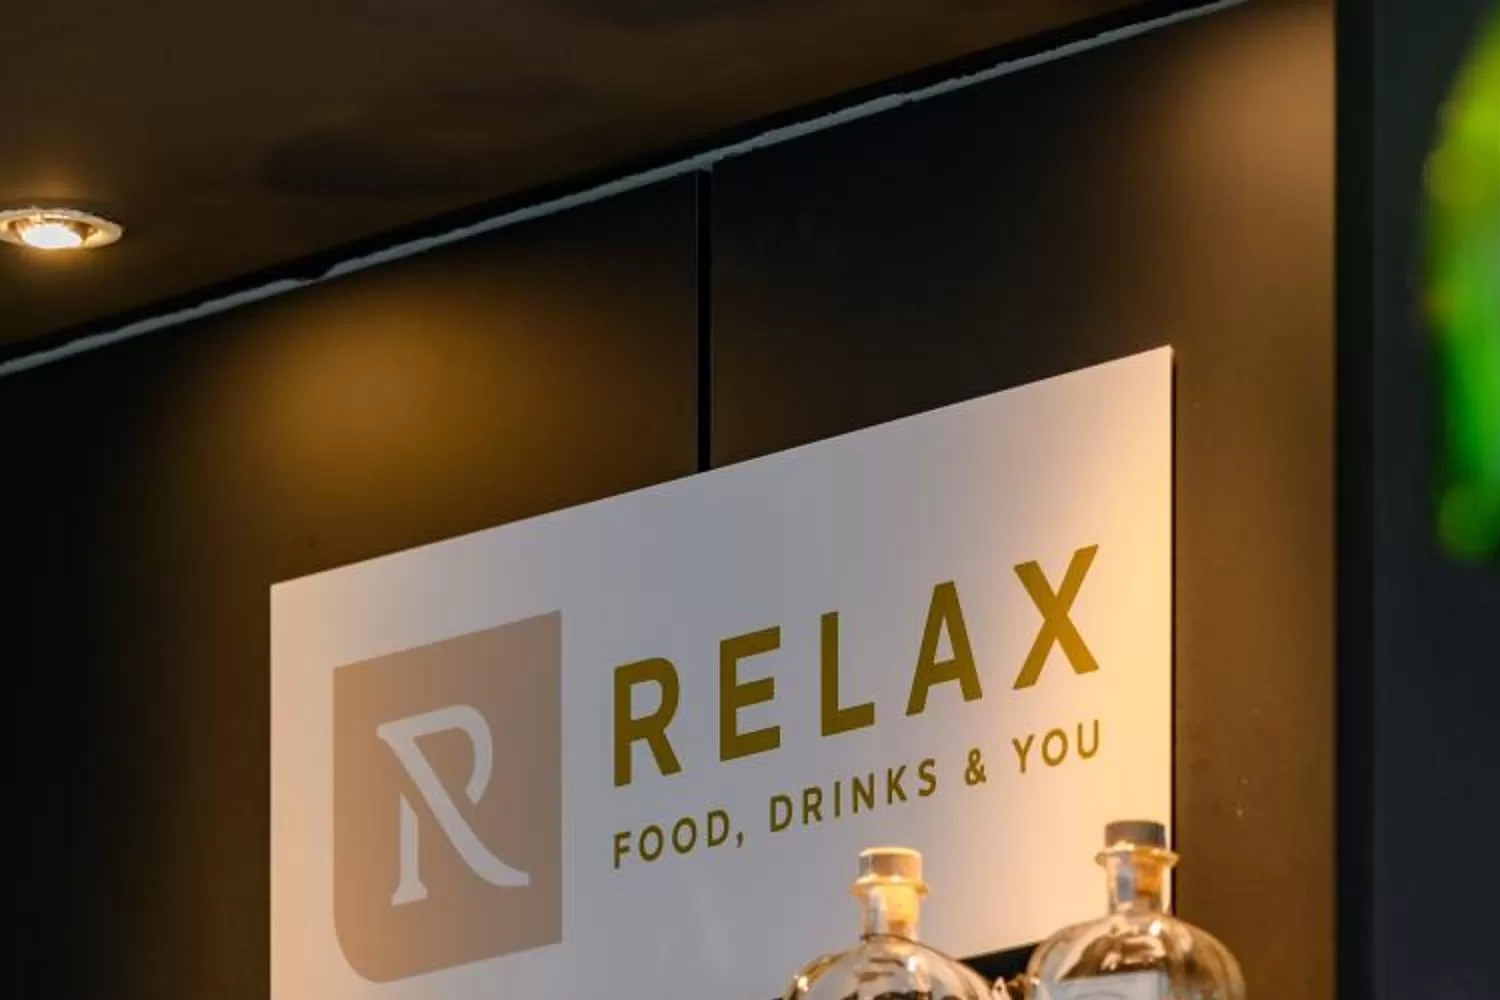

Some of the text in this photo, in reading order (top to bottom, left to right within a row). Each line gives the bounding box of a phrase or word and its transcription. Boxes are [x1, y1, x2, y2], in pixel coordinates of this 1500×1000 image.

[612, 543, 1101, 787] RELAX
[613, 718, 1100, 869] FOOD, DRINKS & YOU
